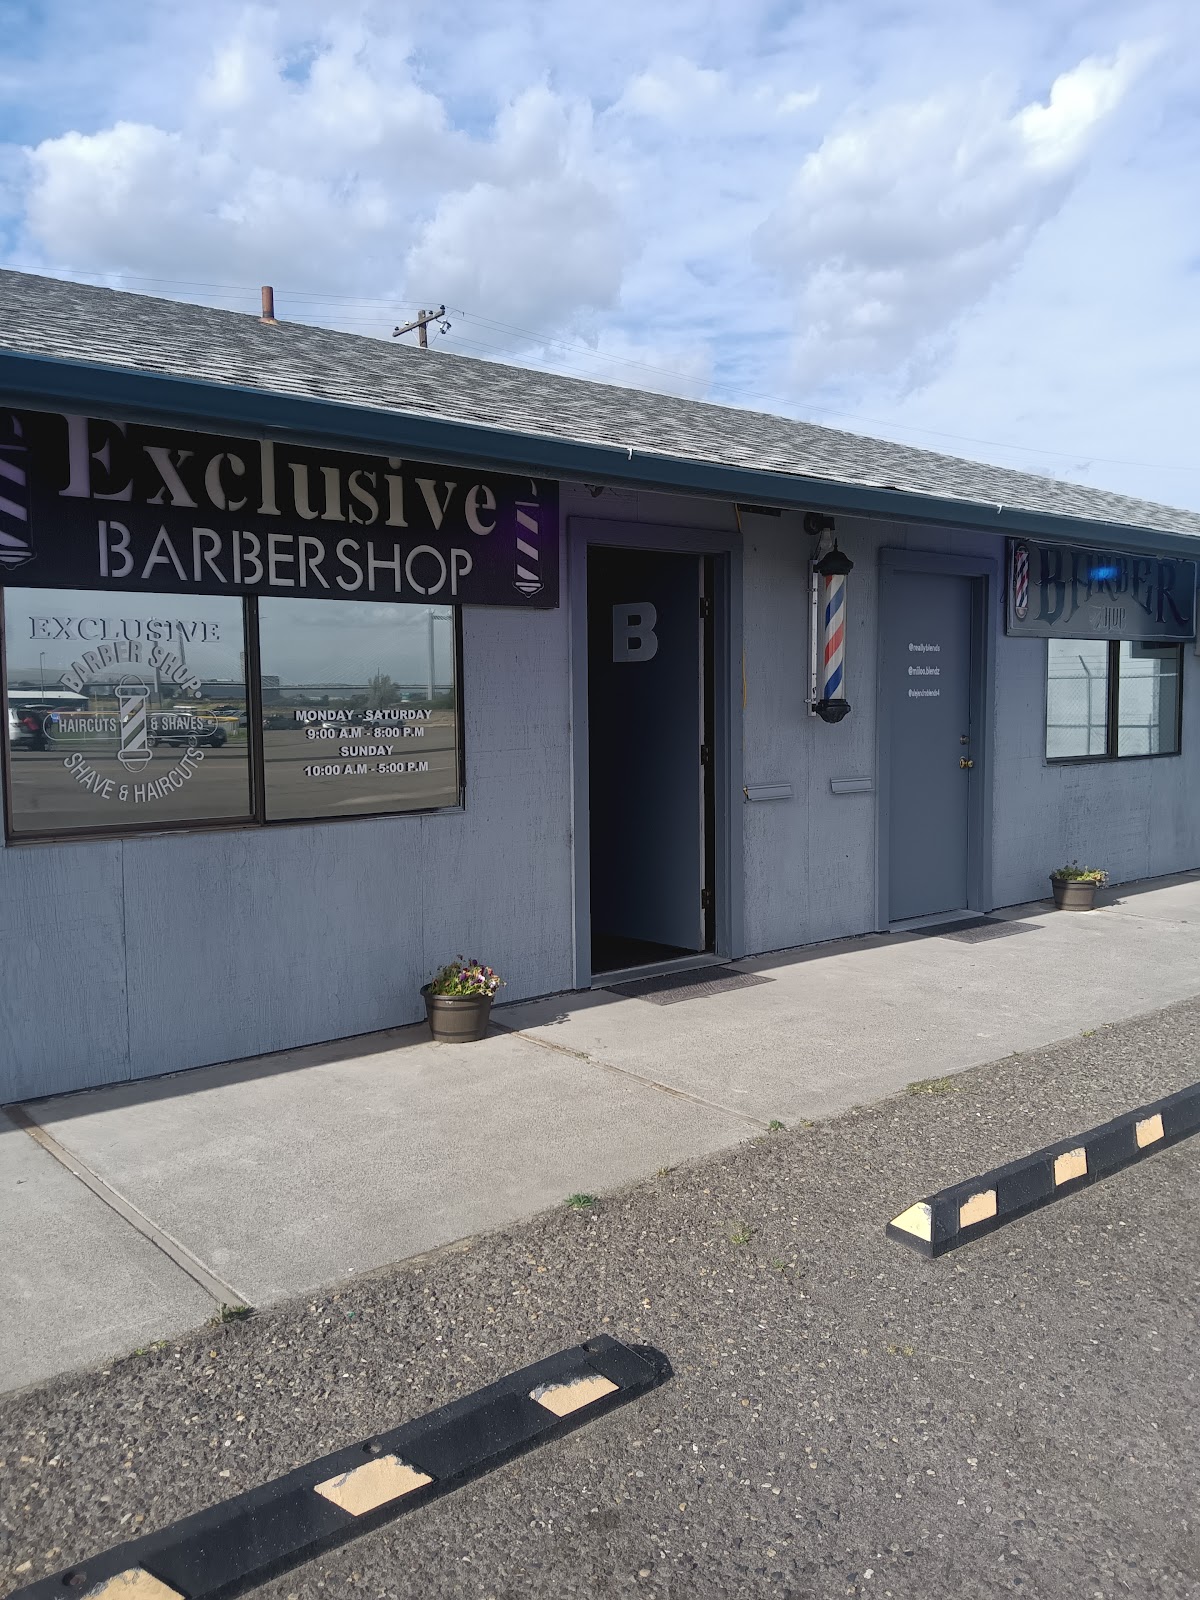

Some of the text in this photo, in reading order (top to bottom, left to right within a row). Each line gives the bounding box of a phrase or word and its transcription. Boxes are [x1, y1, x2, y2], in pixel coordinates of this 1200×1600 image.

[59, 413, 497, 537] Exclusive
[99, 520, 473, 596] BARBERSHOP
[1033, 547, 1190, 625] BARBER
[29, 616, 221, 642] EXCLUSIVE
[613, 602, 658, 662] B
[60, 640, 202, 693] BARBER SHOP
[59, 717, 204, 733] HAIRCUTS & SHAVES
[294, 710, 354, 721] MONDAY
[364, 709, 432, 721] SATURDAY
[306, 728, 336, 740] 9:00
[339, 727, 362, 739] A.M
[373, 727, 400, 738] 8:00
[403, 726, 425, 738] P.M
[304, 765, 341, 777] 10:00
[342, 763, 367, 775] A.M
[377, 762, 404, 773] 5:00
[407, 761, 429, 772] P.M
[339, 745, 394, 757] SUNDAY
[63, 747, 205, 803] SHAVE & HAIRCUTS
